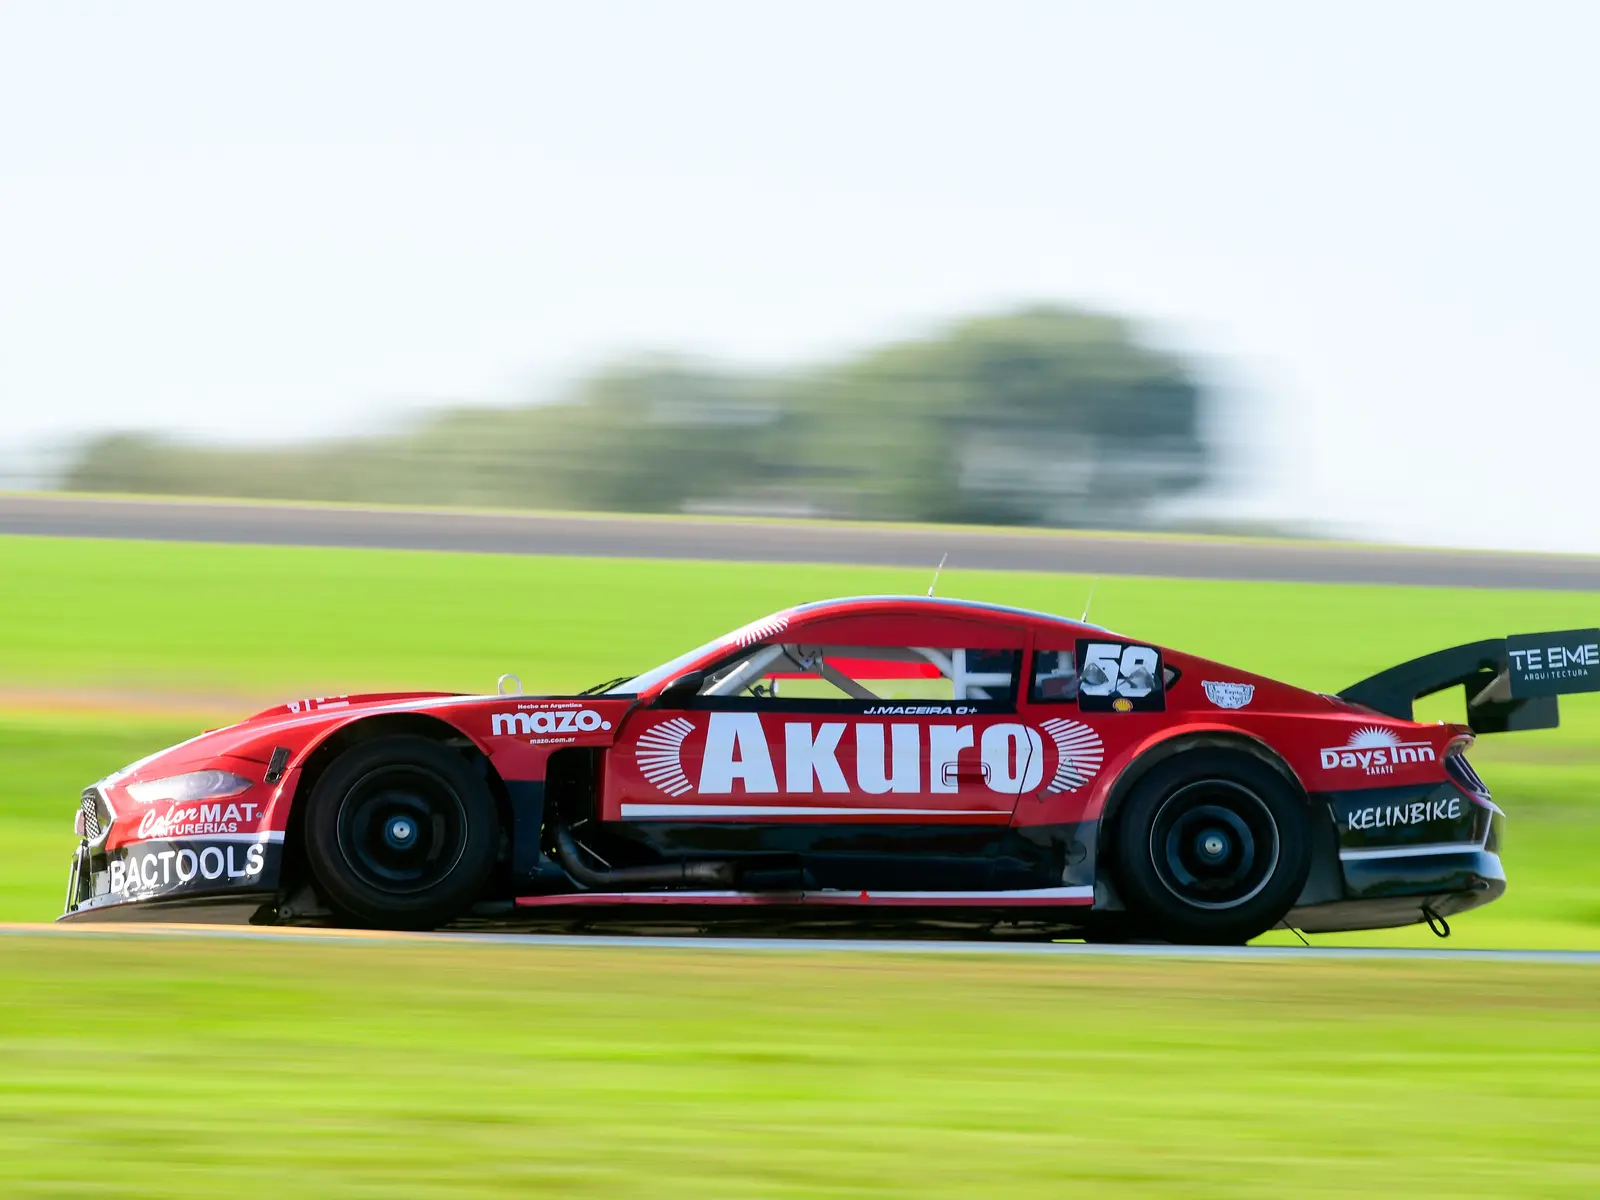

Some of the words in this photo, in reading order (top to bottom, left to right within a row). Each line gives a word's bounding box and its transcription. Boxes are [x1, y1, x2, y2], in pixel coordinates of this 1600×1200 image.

[1509, 648, 1542, 671] TE
[1547, 644, 1599, 668] EME
[1524, 669, 1588, 681] ARQUITECTURA
[864, 706, 953, 715] J.MACEIRA
[530, 737, 576, 745] mazo.com.ar
[1321, 749, 1388, 769] Days
[1390, 746, 1436, 763] Inn
[138, 804, 199, 839] Color
[200, 803, 258, 823] MAT
[1348, 797, 1462, 831] KELINBIKE
[150, 822, 238, 838] NTURERIAS
[110, 843, 265, 894] BACTOOLS
